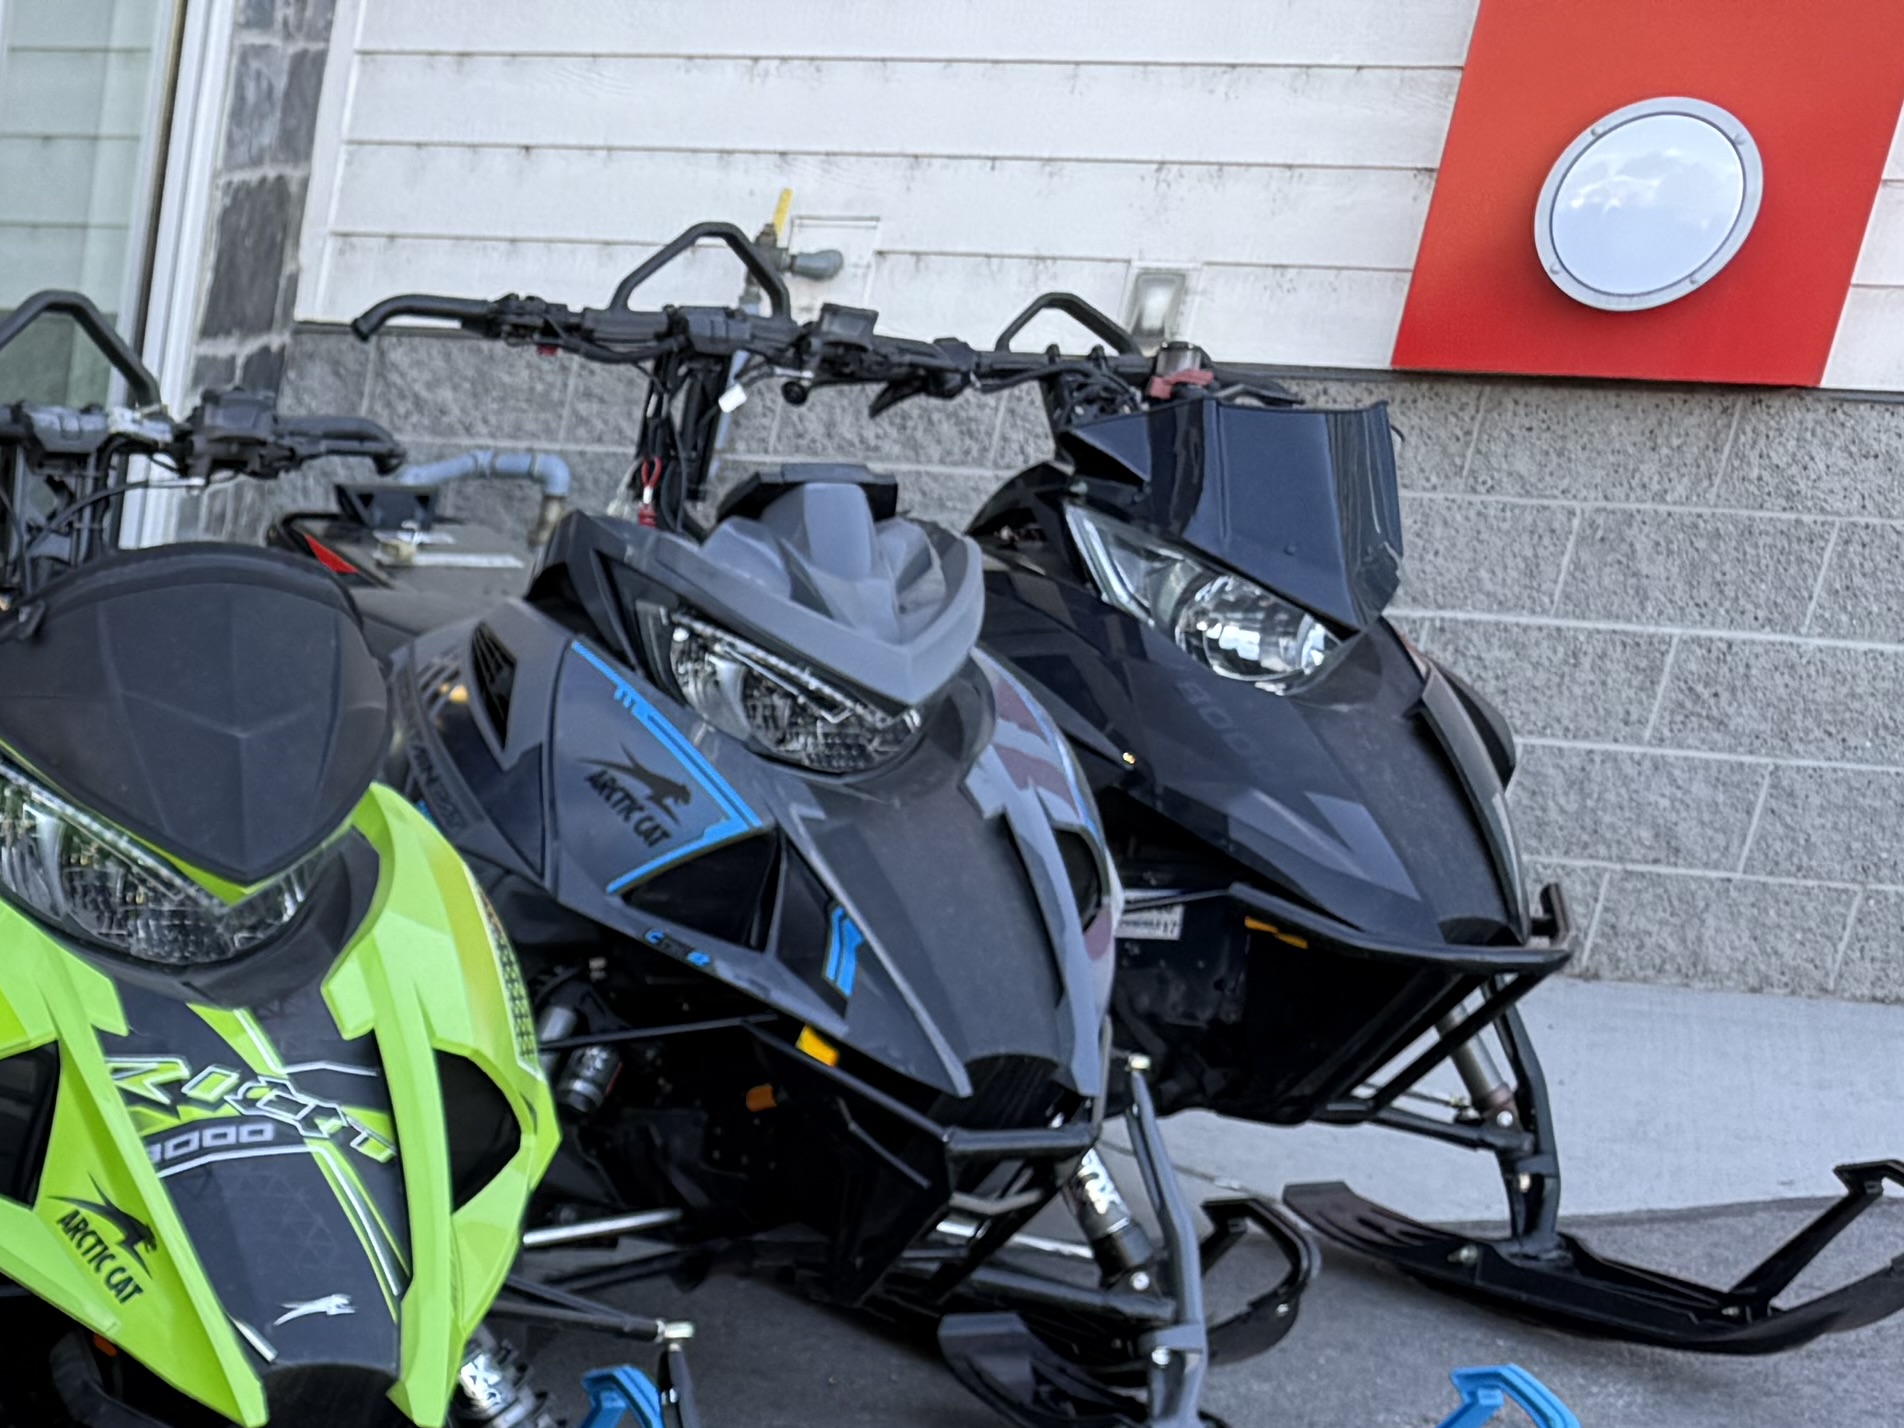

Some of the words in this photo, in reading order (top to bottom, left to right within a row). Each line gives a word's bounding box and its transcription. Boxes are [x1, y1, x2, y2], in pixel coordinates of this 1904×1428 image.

[584, 768, 635, 823] ARCTIC
[632, 811, 674, 848] CAT
[56, 1209, 117, 1274] ARCTIC
[104, 1264, 145, 1305] CAT
